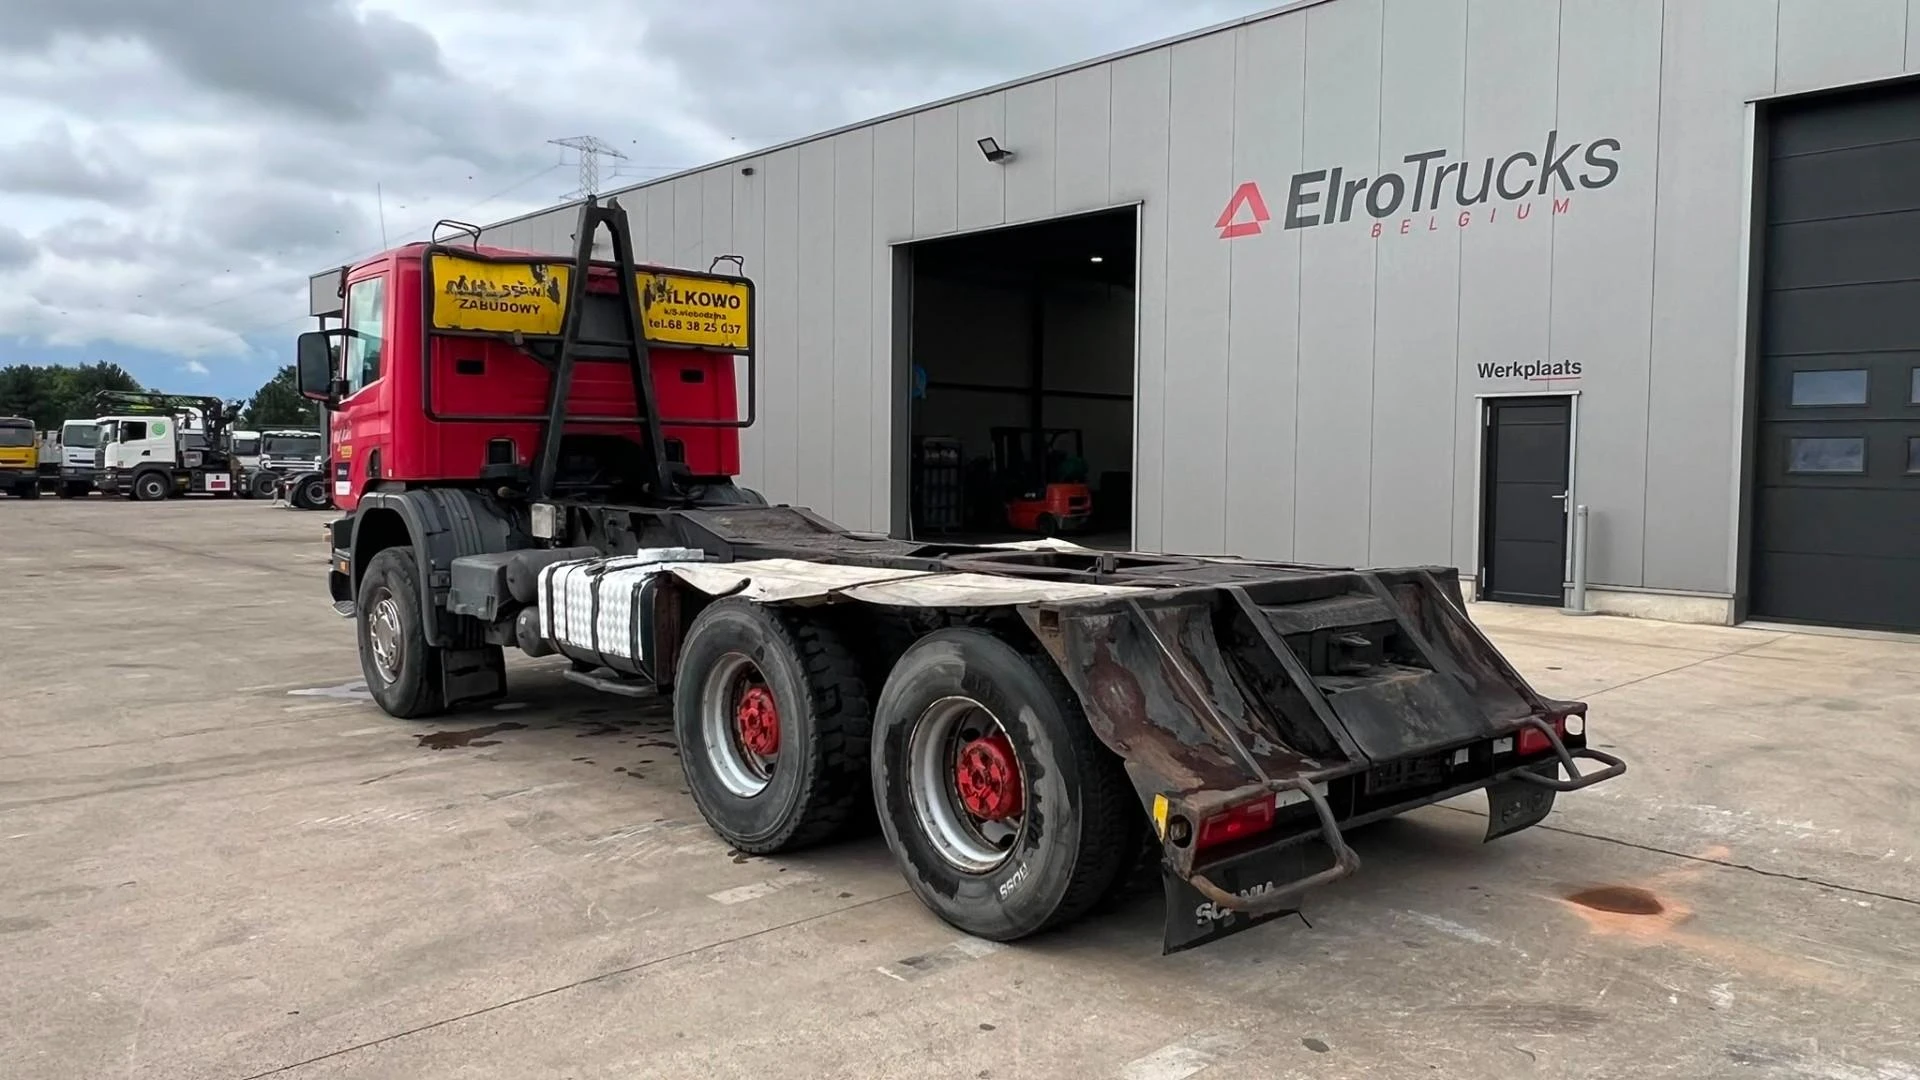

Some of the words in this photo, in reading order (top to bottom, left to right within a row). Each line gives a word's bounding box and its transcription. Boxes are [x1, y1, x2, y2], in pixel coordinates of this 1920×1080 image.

[1284, 130, 1621, 230] ElroTrucks
[1371, 198, 1570, 238] BELGIUM
[459, 299, 540, 315] ZABUDOWY
[686, 321, 700, 331] 38
[704, 322, 717, 333] 25
[721, 323, 741, 335] 037
[1477, 360, 1582, 379] Werkplaats
